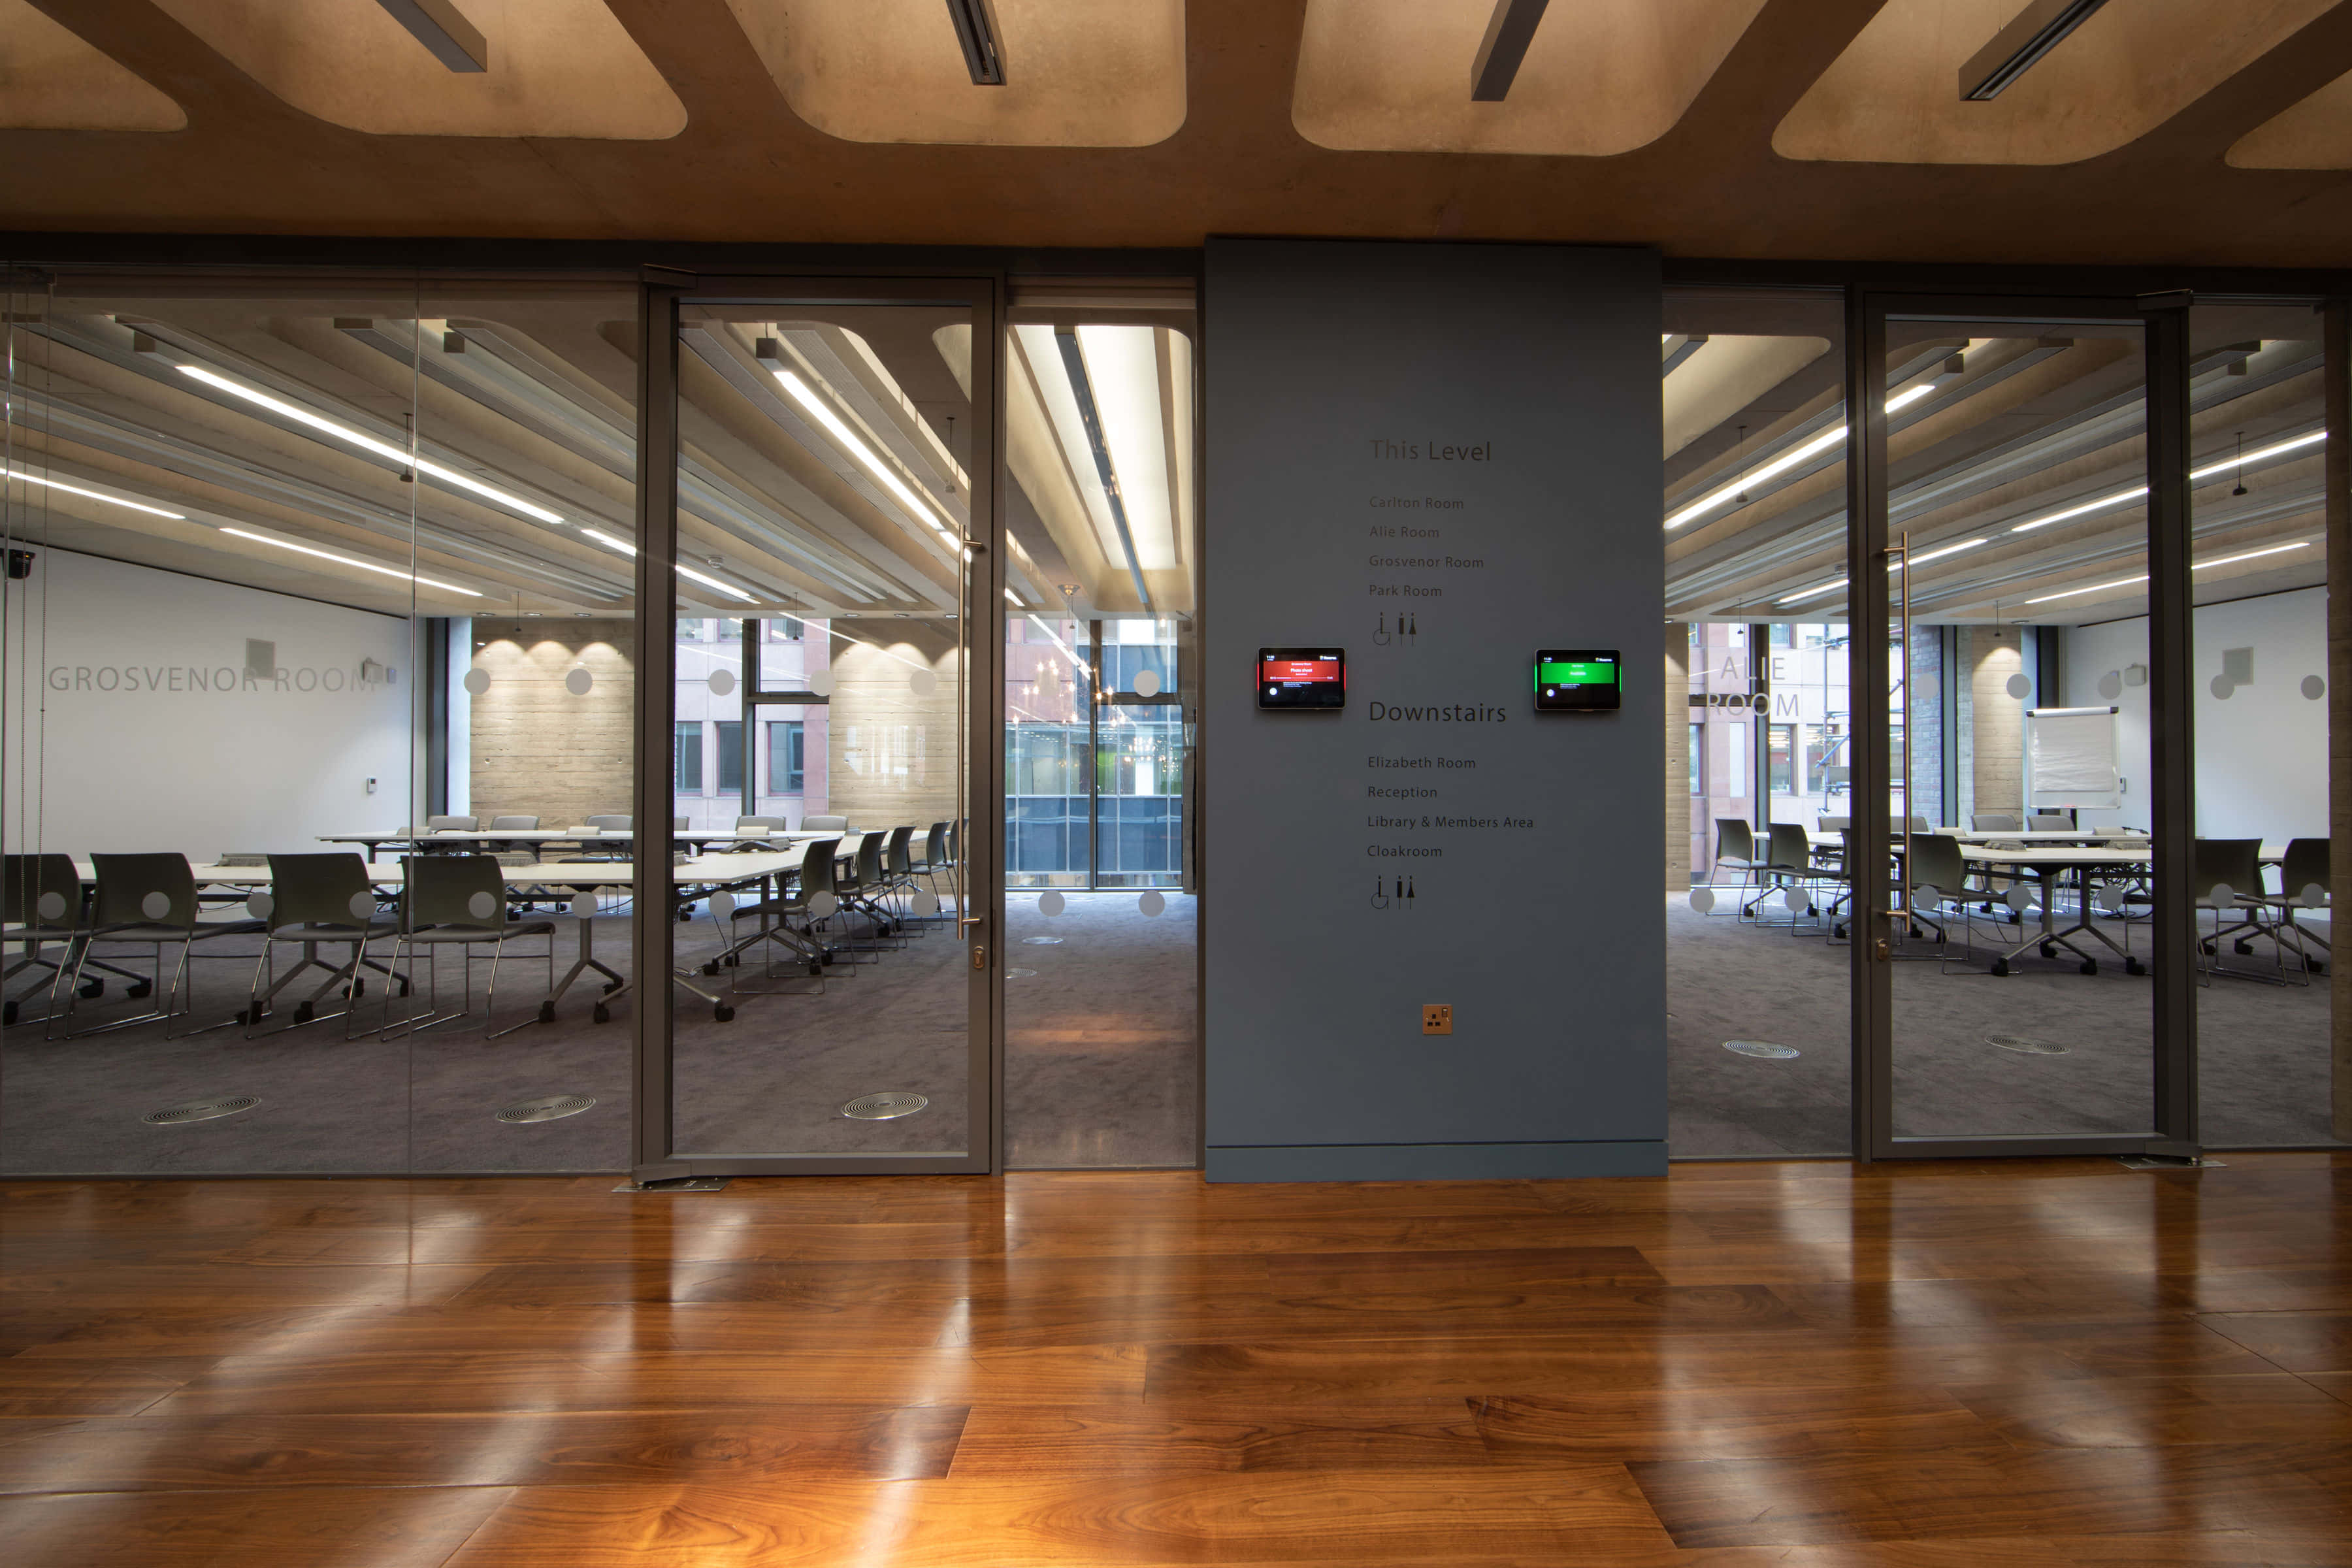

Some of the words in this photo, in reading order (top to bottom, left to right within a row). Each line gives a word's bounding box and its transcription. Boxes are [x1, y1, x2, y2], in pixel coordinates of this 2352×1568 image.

[1369, 439, 1419, 460] This
[1429, 441, 1490, 461] Level
[1369, 496, 1420, 508] Carlton
[1425, 497, 1464, 510] Room
[1369, 526, 1396, 538] Alie
[1401, 527, 1440, 538] Room
[1369, 555, 1441, 568] Grosvenor
[1446, 557, 1484, 568] Room
[1369, 585, 1399, 596] Park
[1404, 585, 1443, 597] Room
[1720, 656, 1786, 681] ALIE
[48, 666, 259, 692] GROSVENOR
[274, 667, 377, 693] ROOM
[1369, 701, 1507, 723] Downstairs
[1706, 693, 1799, 717] ROOM
[1368, 757, 1432, 768] Elizabeth
[1437, 757, 1476, 769] Room
[1368, 786, 1438, 800] Reception
[1367, 816, 1416, 830] Library
[1421, 817, 1431, 828] &
[1435, 817, 1499, 828] Members
[1503, 817, 1534, 828] Area
[1367, 845, 1443, 857] Cloakroom
